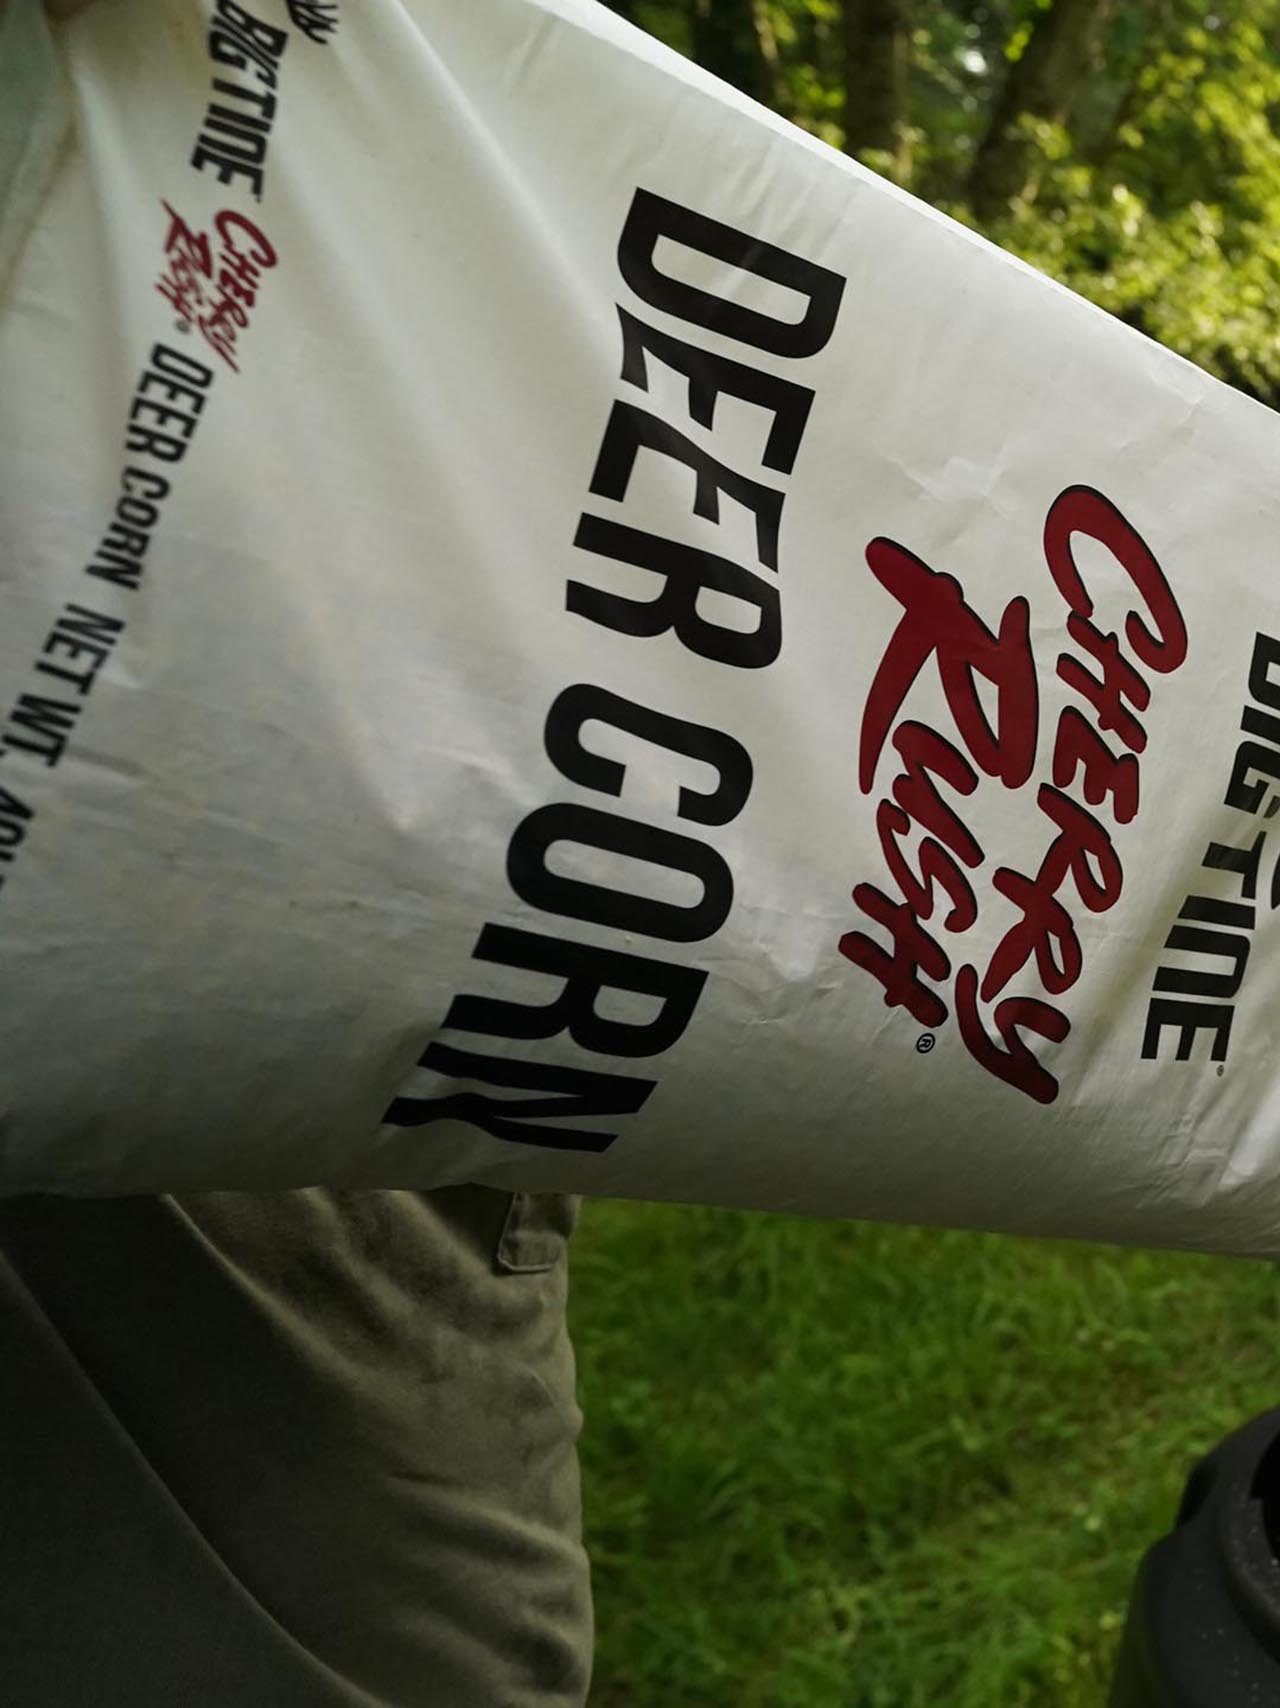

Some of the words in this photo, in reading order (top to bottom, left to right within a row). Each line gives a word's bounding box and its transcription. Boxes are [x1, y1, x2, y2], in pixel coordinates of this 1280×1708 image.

[209, 0, 288, 89] BIG
[190, 78, 278, 200] TINE
[155, 198, 214, 323] RUSH
[198, 209, 278, 374] CHERRY
[125, 343, 214, 463] DEER
[565, 187, 847, 669] DEER
[85, 466, 171, 591] CORN
[34, 604, 126, 696] NET
[838, 536, 1039, 1028] RUSH
[955, 484, 1188, 1104] CHERRY
[381, 683, 753, 1153] CORN
[1141, 831, 1268, 1063] TINE
